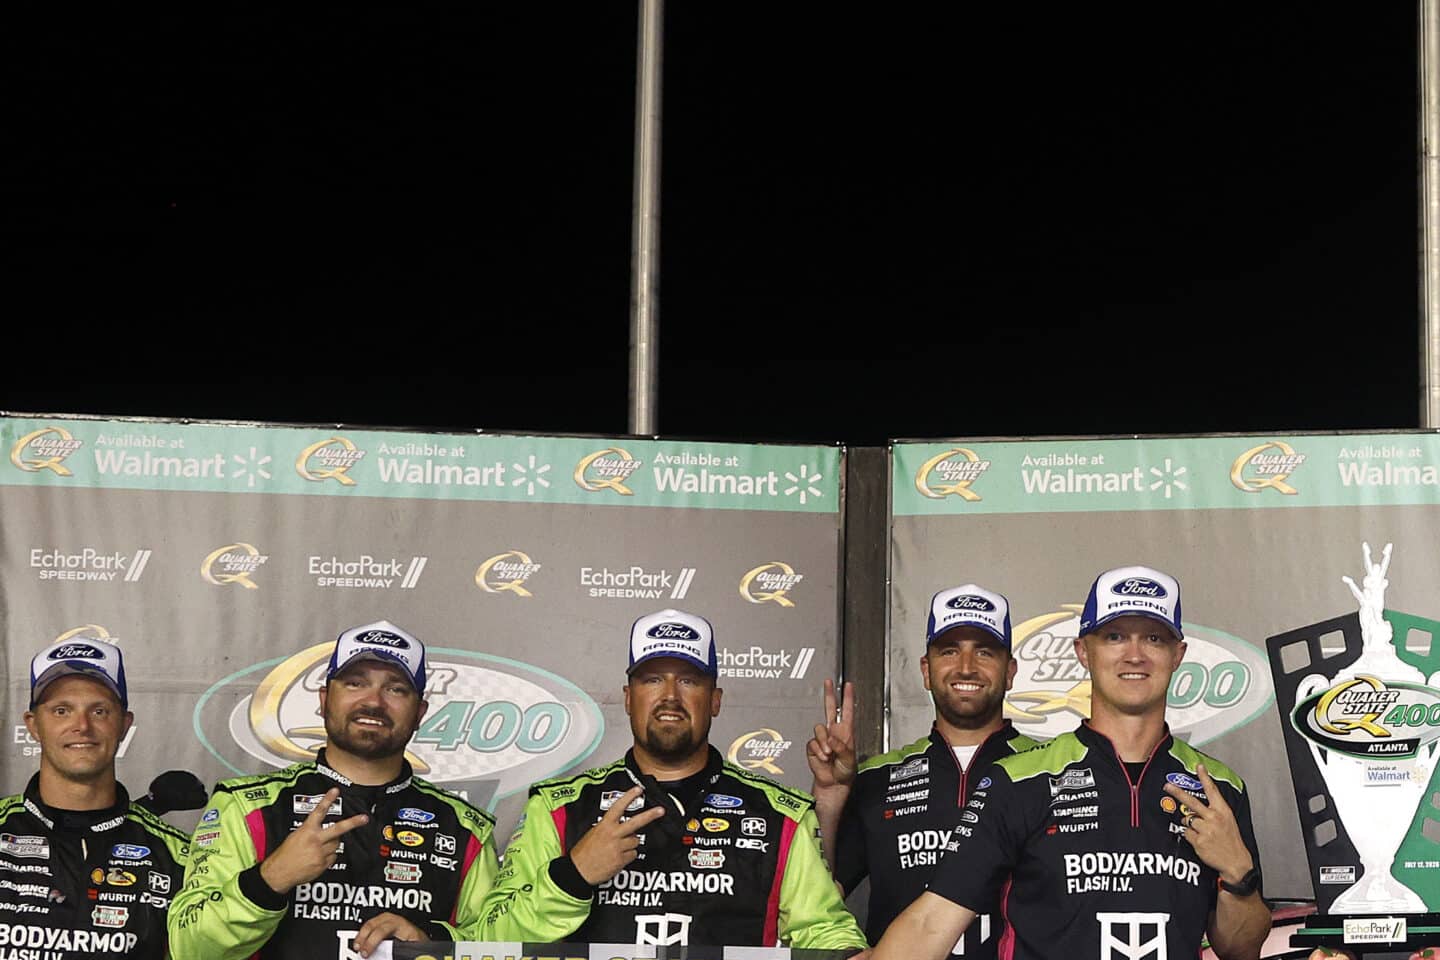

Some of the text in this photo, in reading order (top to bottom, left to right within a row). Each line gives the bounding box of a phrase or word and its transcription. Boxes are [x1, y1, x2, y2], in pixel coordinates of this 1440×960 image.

[31, 436, 83, 449] QUAKER
[96, 433, 185, 449] Available at
[315, 445, 367, 460] QUAKER
[378, 443, 465, 457] Available at
[1338, 447, 1422, 459] Available at
[95, 450, 225, 478] Walmart
[319, 456, 356, 468] STATE
[593, 456, 643, 469] QUAKER
[654, 451, 738, 467] Available at
[935, 459, 992, 472] QUAKER
[1022, 453, 1104, 466] Available at
[1250, 452, 1306, 465] QUAKER
[379, 458, 505, 487] Walmart
[597, 466, 633, 477] STATE
[940, 469, 981, 481] STATE
[1256, 462, 1295, 474] STATE
[654, 468, 778, 496] Walmart
[1022, 468, 1143, 494] Walmart
[30, 548, 126, 570] EchoPark
[309, 556, 402, 577] EchoPark
[494, 561, 541, 573] QUAKER
[39, 570, 116, 581] SPEEDWAY
[581, 567, 671, 587] EchoPark
[756, 571, 803, 583] QUAKER
[317, 577, 393, 589] SPEEDWAY
[1126, 578, 1157, 597] Ford
[589, 588, 663, 599] SPEEDWAY
[956, 596, 987, 611] Ford
[1108, 598, 1168, 614] RACING
[943, 612, 996, 626] RACING
[364, 631, 402, 646] Ford
[655, 625, 690, 640] Ford
[643, 642, 701, 657] RACING
[1337, 690, 1400, 704] QUAKER
[1344, 702, 1387, 714] STATE
[414, 701, 571, 753] 400
[1368, 743, 1409, 752] ATLANTA
[1368, 770, 1410, 781] Walmart
[245, 790, 269, 799] OMP
[551, 788, 575, 798] OMP
[743, 821, 766, 834] PPG
[1064, 852, 1200, 886] BODYARMOR
[1067, 876, 1133, 894] FLASH I.V.
[296, 882, 432, 913] BODYARMOR
[599, 891, 641, 907] FLASH
[294, 904, 362, 922] FLASH I.V.
[1345, 923, 1391, 935] EchoPark
